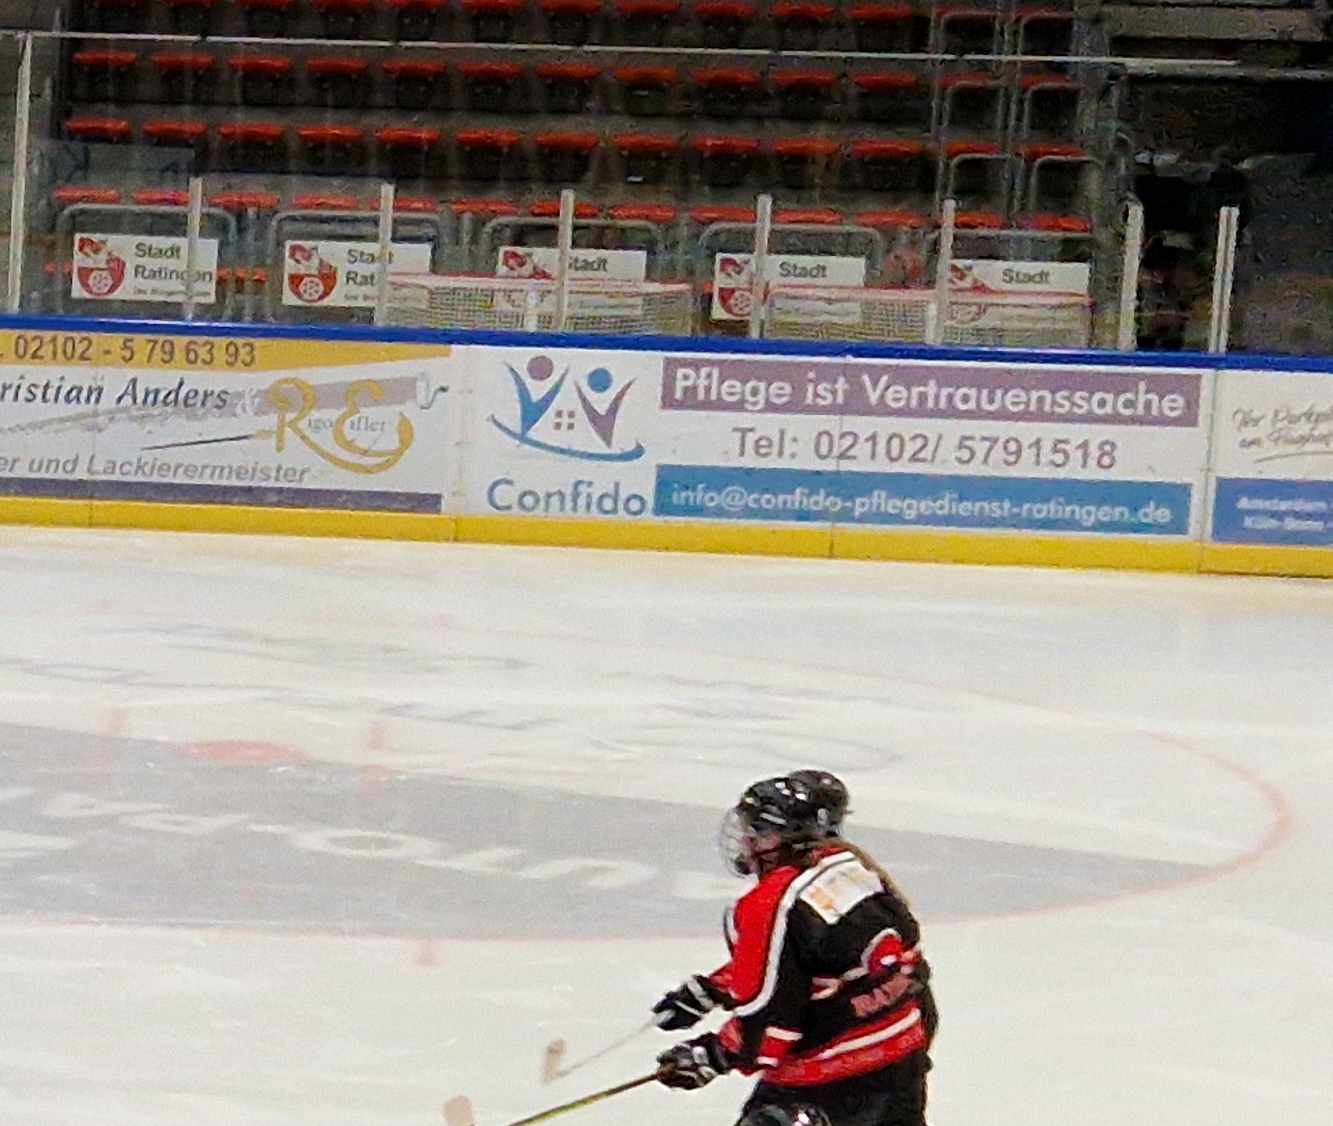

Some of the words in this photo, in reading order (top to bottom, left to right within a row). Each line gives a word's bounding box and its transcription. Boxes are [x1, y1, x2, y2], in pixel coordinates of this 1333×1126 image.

[134, 243, 182, 260] Stadt
[778, 261, 828, 281] Stadt
[1001, 268, 1052, 286] Stadt
[13, 336, 93, 361] 02102
[121, 341, 137, 364] 5
[145, 341, 175, 365] 79
[184, 342, 216, 366] 63
[223, 343, 257, 367] 93
[114, 376, 229, 410] Anders
[673, 366, 793, 408] Pflege
[805, 372, 848, 406] ist
[865, 374, 1188, 420] Vertrauenssache
[733, 428, 799, 460] Tel:
[813, 430, 941, 466] 02102/
[955, 434, 1117, 470] 5791518
[28, 453, 80, 476] und
[86, 454, 310, 485] Lackierermeister
[486, 478, 646, 517] Confido
[670, 485, 1172, 526] info@confido-pflegedienst-ratingen.de
